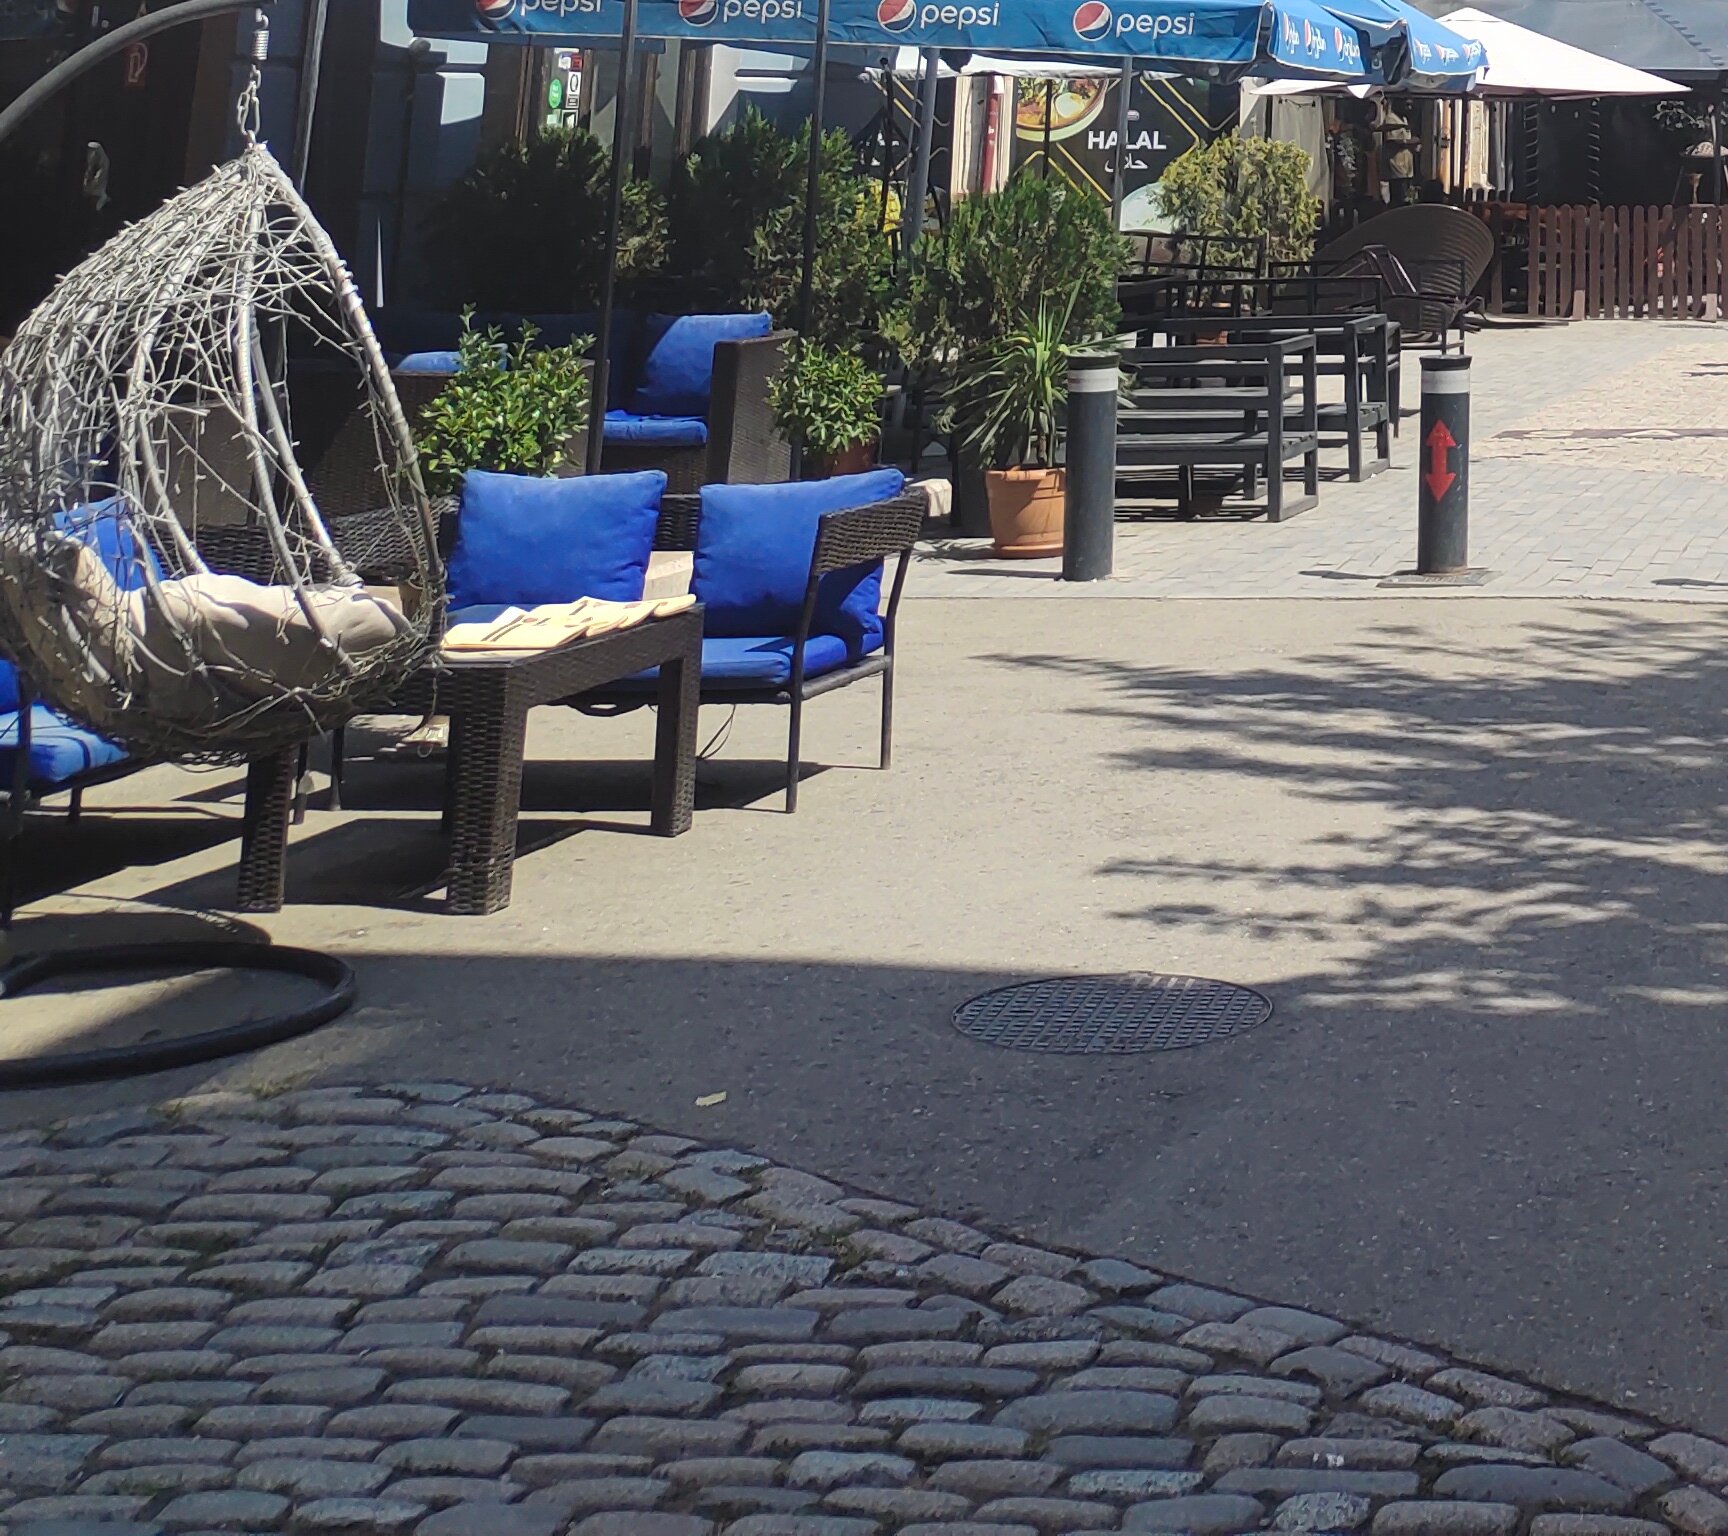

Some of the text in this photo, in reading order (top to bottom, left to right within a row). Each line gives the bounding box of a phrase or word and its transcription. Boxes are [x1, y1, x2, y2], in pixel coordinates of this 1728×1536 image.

[920, 1, 1000, 29] pepsi
[1116, 11, 1195, 40] pepsi
[1087, 130, 1167, 149] HALAL
